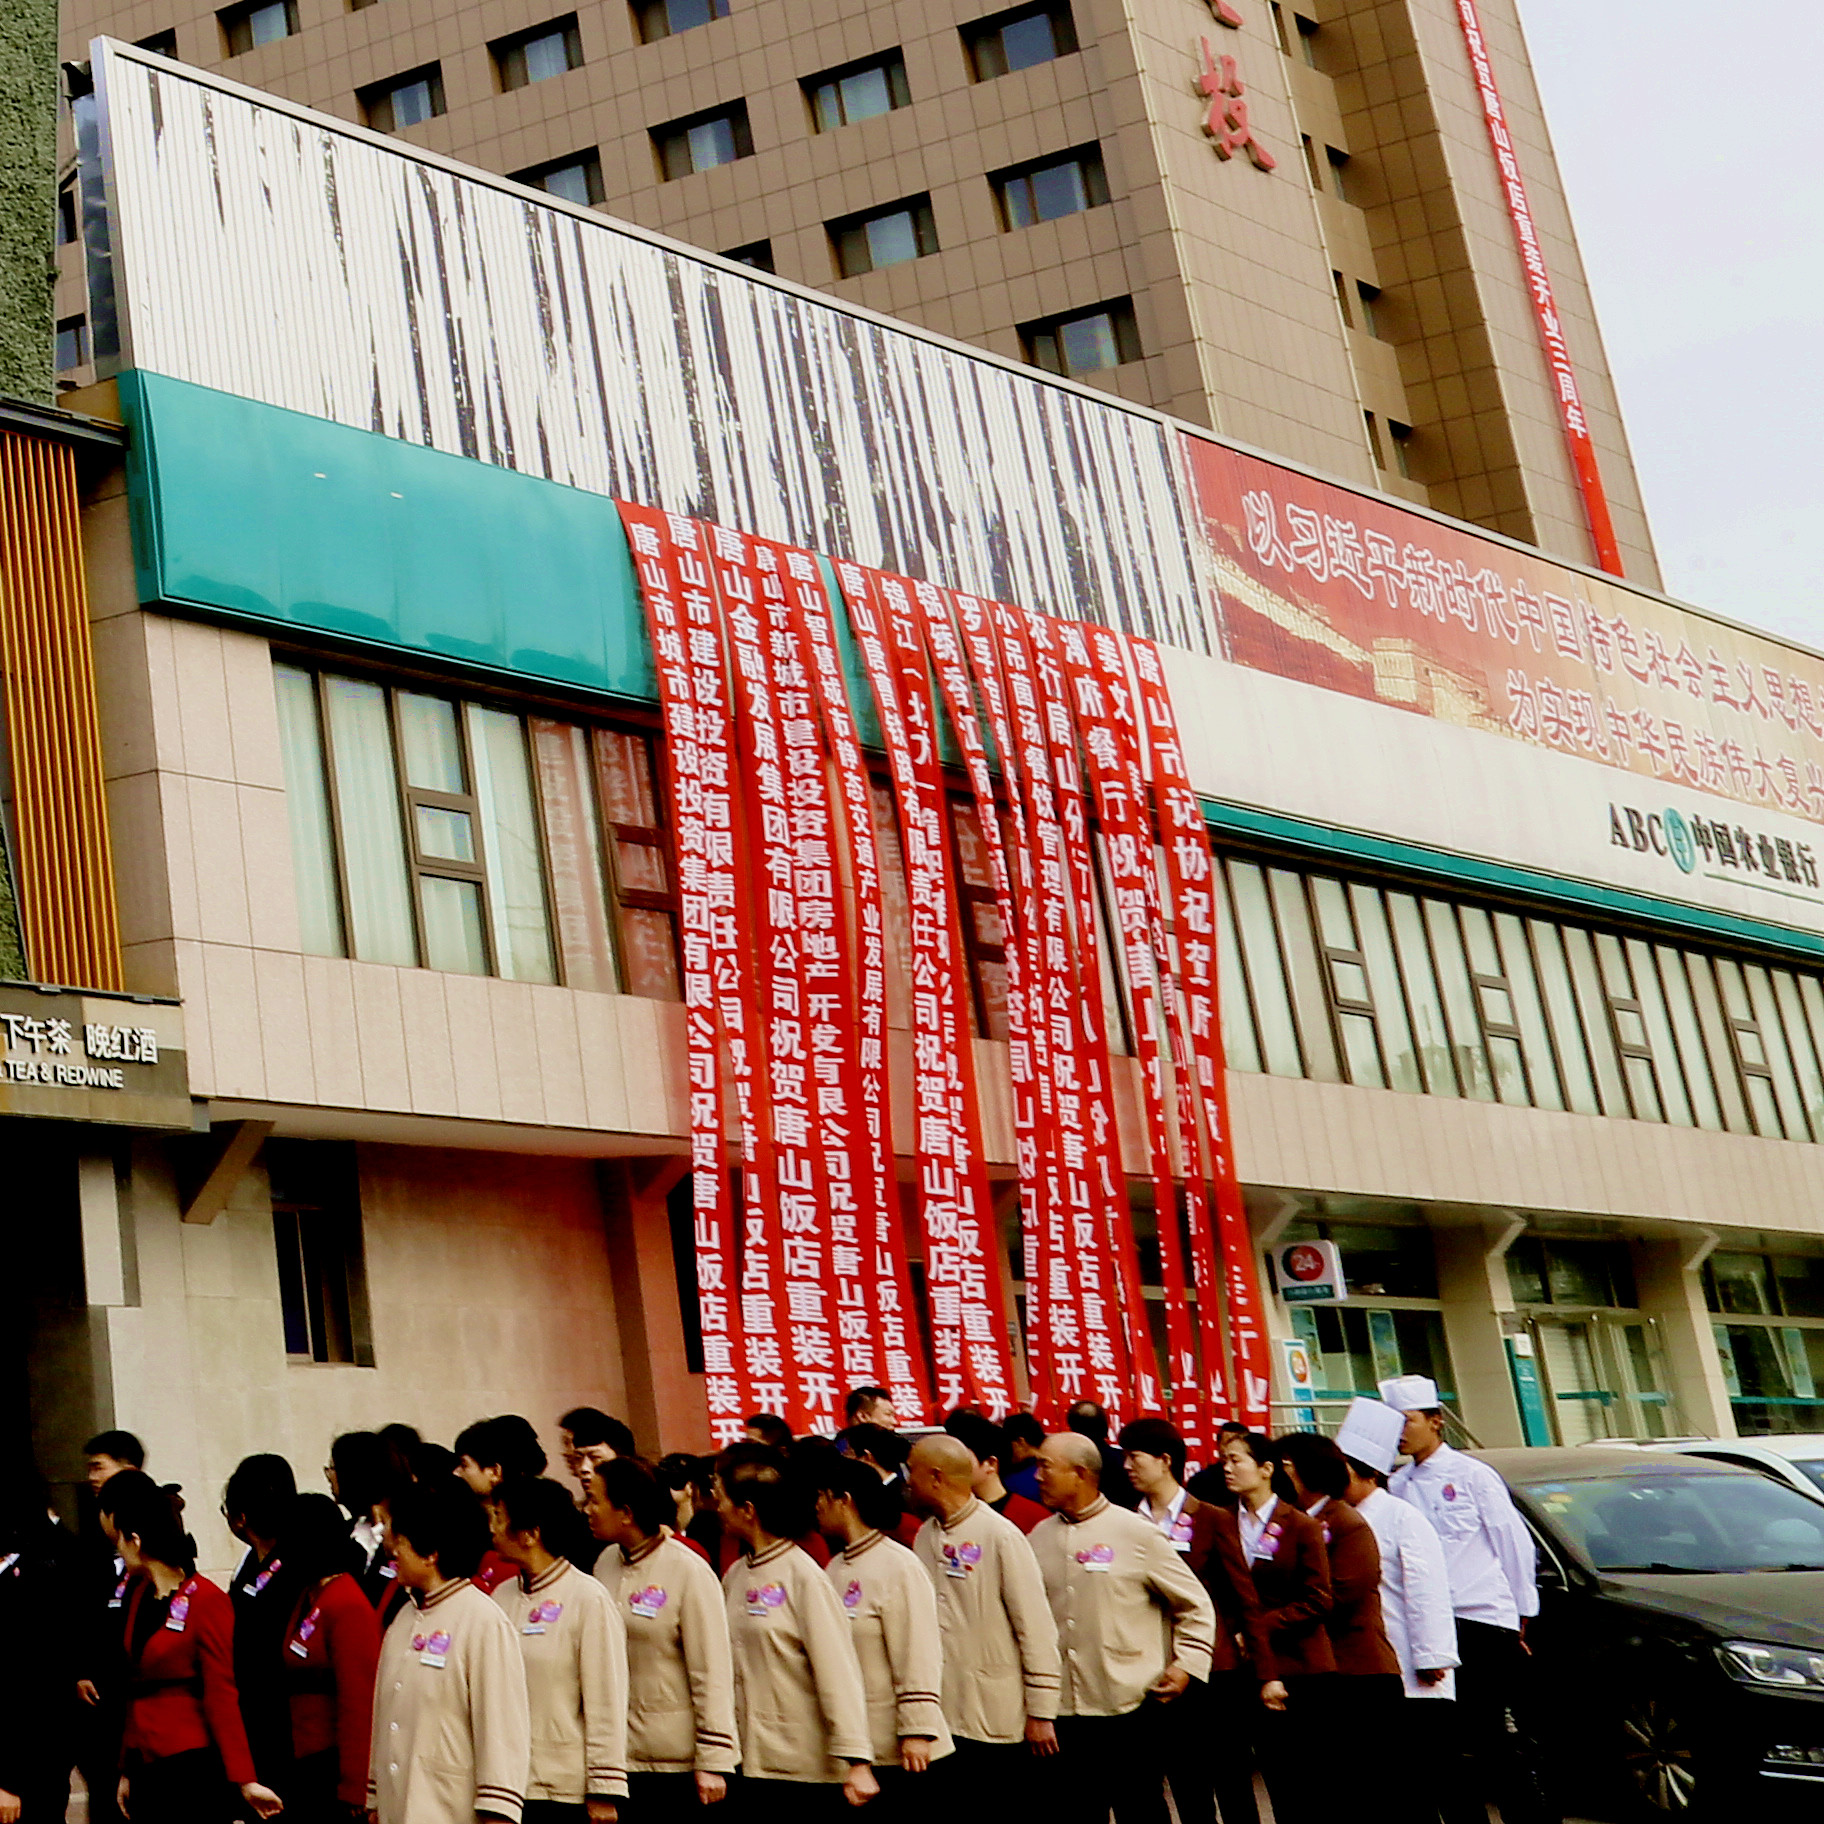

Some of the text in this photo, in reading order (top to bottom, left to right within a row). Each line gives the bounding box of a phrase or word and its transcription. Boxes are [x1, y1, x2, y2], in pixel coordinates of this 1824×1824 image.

[1242, 490, 1824, 743] 以习近平新时代中国特色社会主义思想
[1608, 801, 1668, 857] ABC
[1689, 812, 1820, 889] 中国农业银行
[84, 1022, 159, 1065] 晚红酒
[6, 1060, 39, 1082] TEA
[56, 1063, 125, 1089] REDWINE
